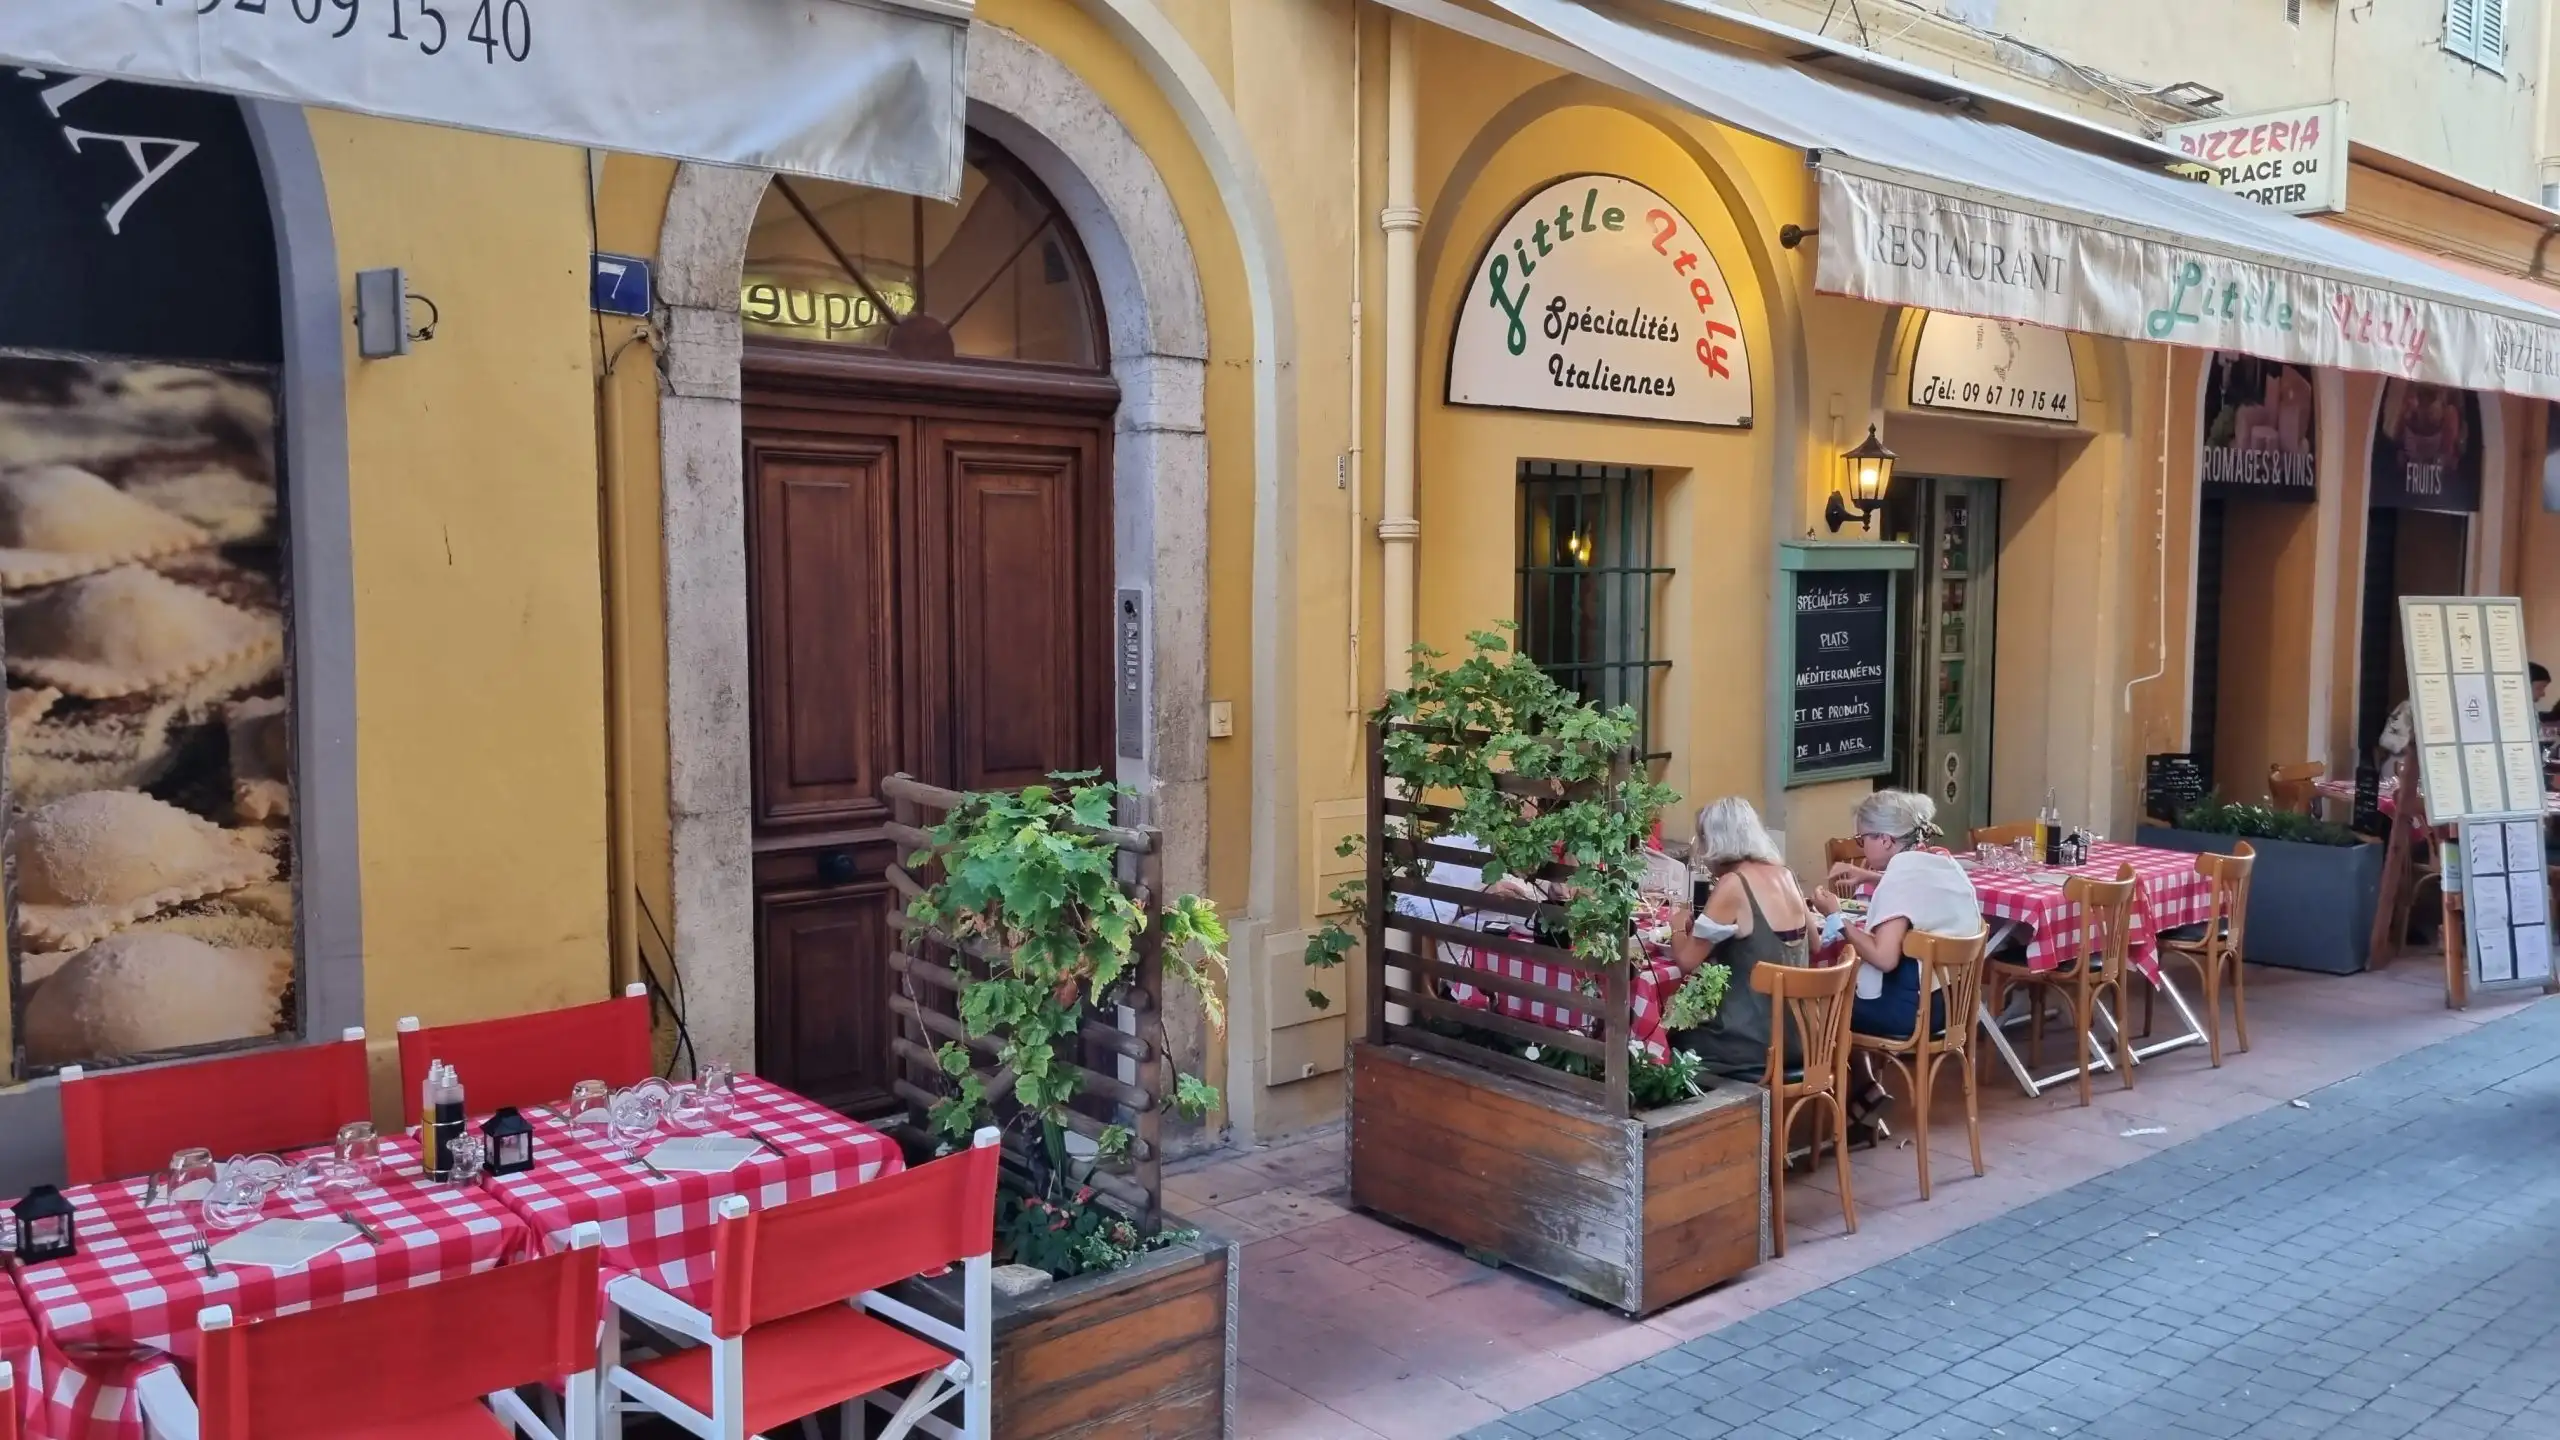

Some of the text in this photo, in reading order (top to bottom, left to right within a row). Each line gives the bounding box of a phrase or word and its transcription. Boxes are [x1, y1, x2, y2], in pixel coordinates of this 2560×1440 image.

[388, 0, 448, 56] 15
[467, 0, 532, 65] 40
[2180, 115, 2320, 162] PIZZERIA
[2219, 159, 2283, 186] PLACE
[1871, 223, 2067, 295] RESTAURANT
[597, 260, 628, 300] 7
[1489, 187, 1738, 380] Little Italy
[2146, 261, 2293, 338] Little
[1543, 295, 1680, 346] Spécialités
[1548, 353, 1677, 397] Italiennes
[1923, 375, 2067, 412] Tél: 09 67 19 15 44
[2405, 461, 2443, 496] FRUITS
[1857, 592, 1872, 605] DE
[1819, 630, 1849, 648] PLATS
[1796, 660, 1882, 686] MÉDITERRANÉENS
[1794, 695, 1870, 722] ET DE PRODUITS
[1796, 744, 1809, 758] DE
[1818, 742, 1832, 755] LA
